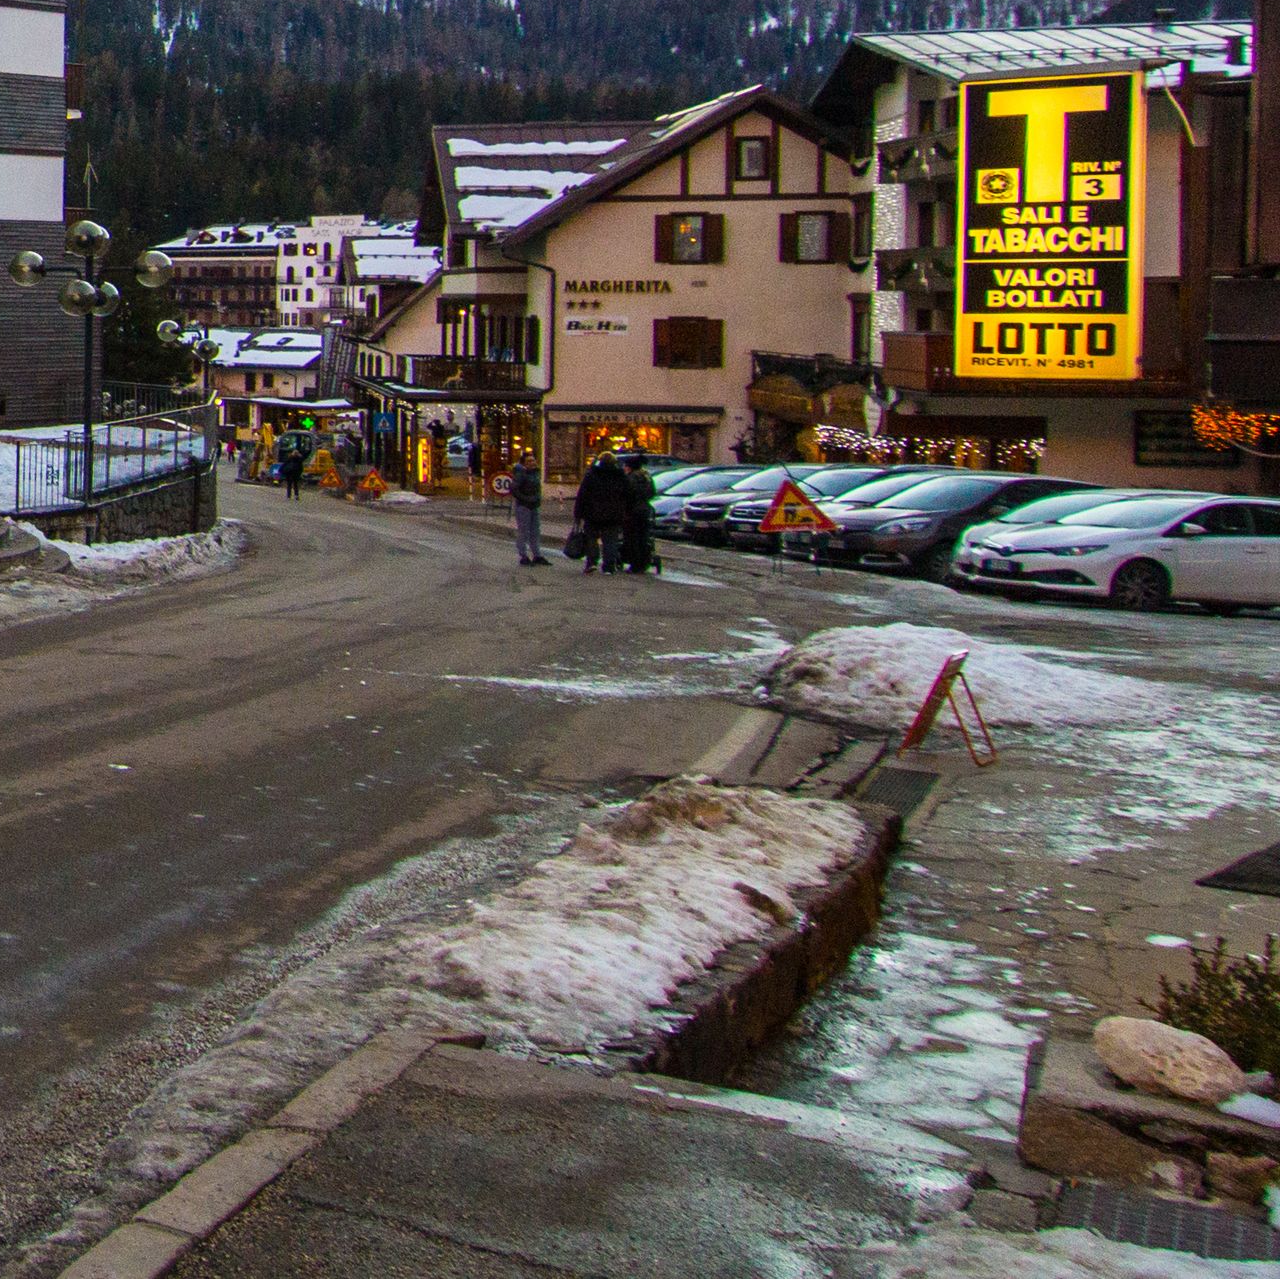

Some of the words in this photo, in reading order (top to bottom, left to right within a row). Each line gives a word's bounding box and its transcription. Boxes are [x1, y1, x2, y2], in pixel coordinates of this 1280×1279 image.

[988, 85, 1109, 203] T
[1071, 161, 1101, 172] RIV.
[1085, 178, 1104, 196] 3
[1001, 206, 1062, 225] SALI
[1070, 205, 1089, 222] E
[968, 226, 1125, 253] TABACCHI
[564, 280, 672, 293] MARGHERITA
[992, 268, 1096, 287] VALORI
[986, 289, 1104, 308] BOLLATI
[972, 321, 1118, 356] LOTTO
[971, 357, 1031, 367] RICEVIT.
[1056, 359, 1095, 368] 4981
[494, 478, 511, 490] 30
